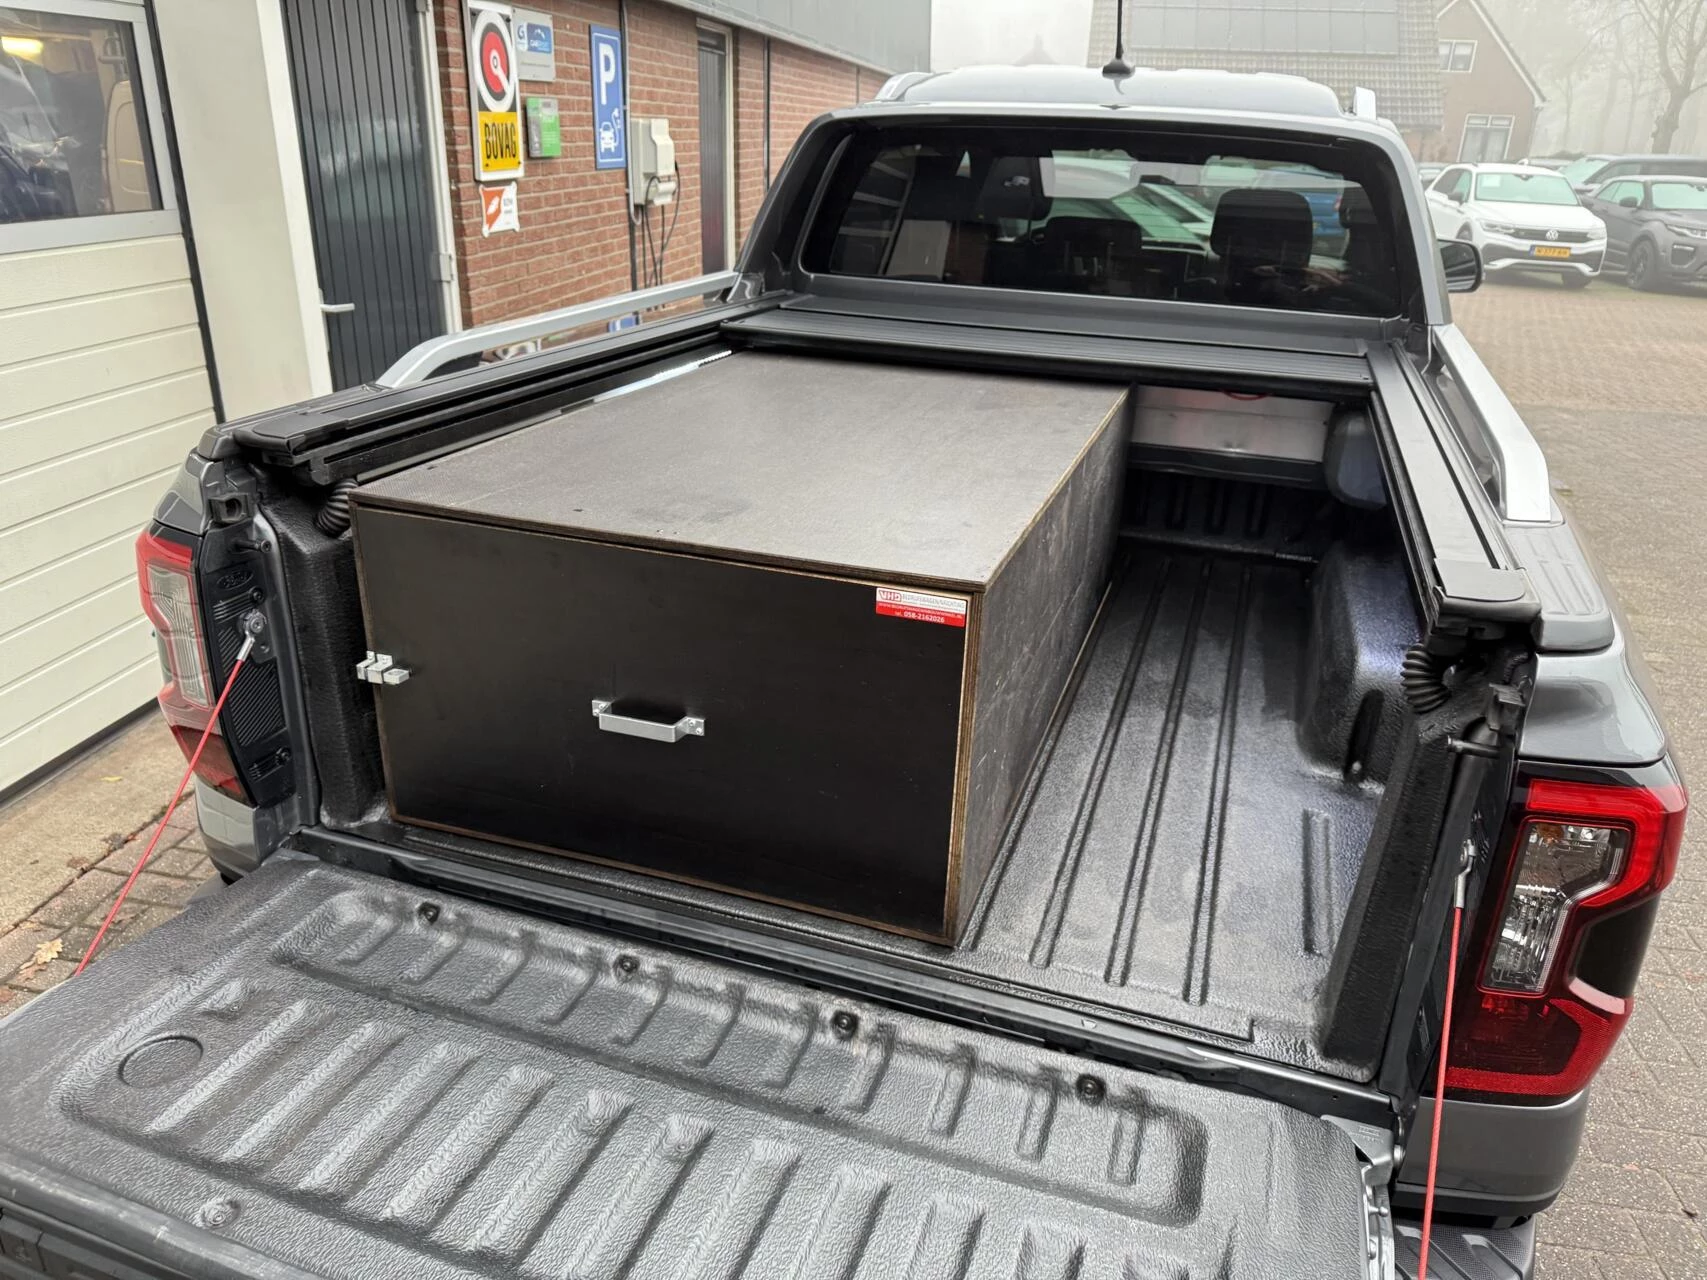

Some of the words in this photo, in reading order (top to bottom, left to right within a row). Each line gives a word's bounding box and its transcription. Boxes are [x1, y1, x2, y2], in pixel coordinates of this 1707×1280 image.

[598, 42, 616, 105] P
[484, 122, 517, 160] BOVAG
[904, 611, 945, 623] 058-2162026
